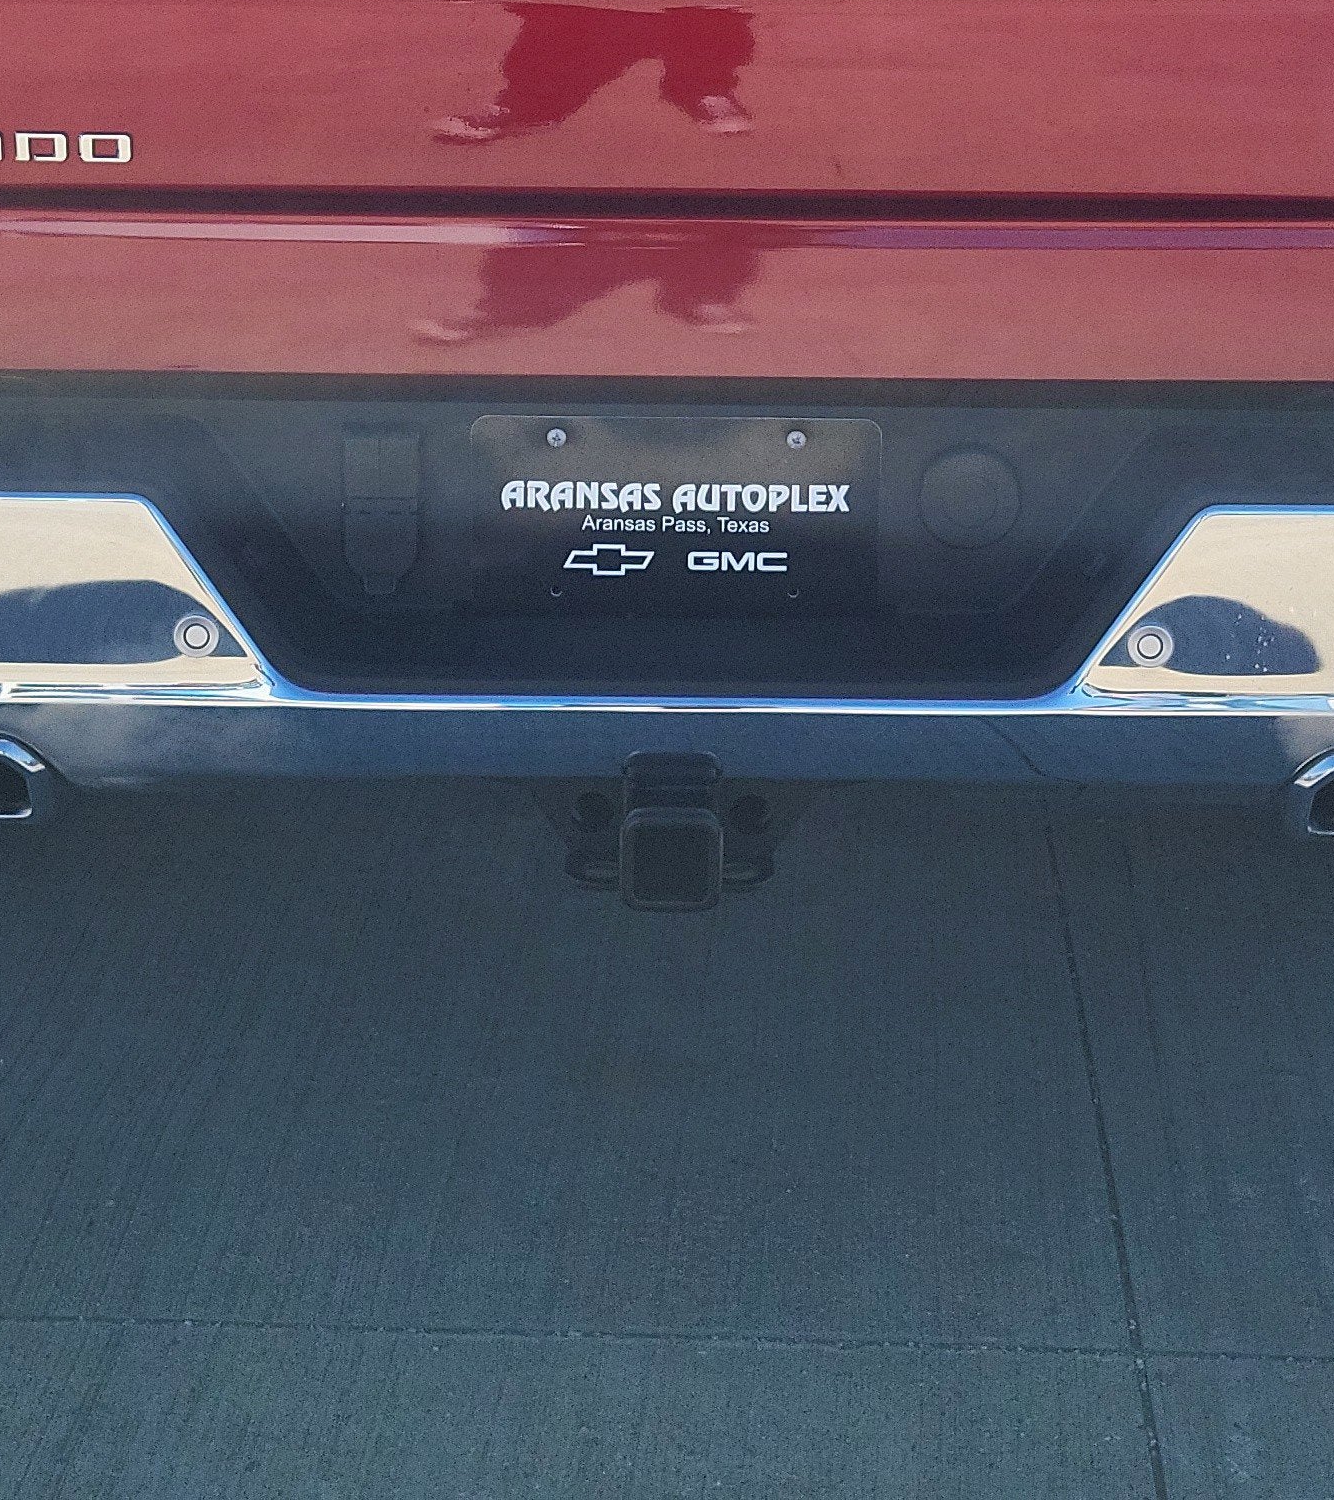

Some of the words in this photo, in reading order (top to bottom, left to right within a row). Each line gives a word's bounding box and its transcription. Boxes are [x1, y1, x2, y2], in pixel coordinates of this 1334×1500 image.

[501, 480, 662, 512] ARANSAS
[672, 483, 851, 514] AUTOPLEX
[581, 514, 656, 532] Aransas
[662, 516, 712, 535] Pass,
[717, 517, 770, 534] Texas
[687, 550, 788, 572] GMC
